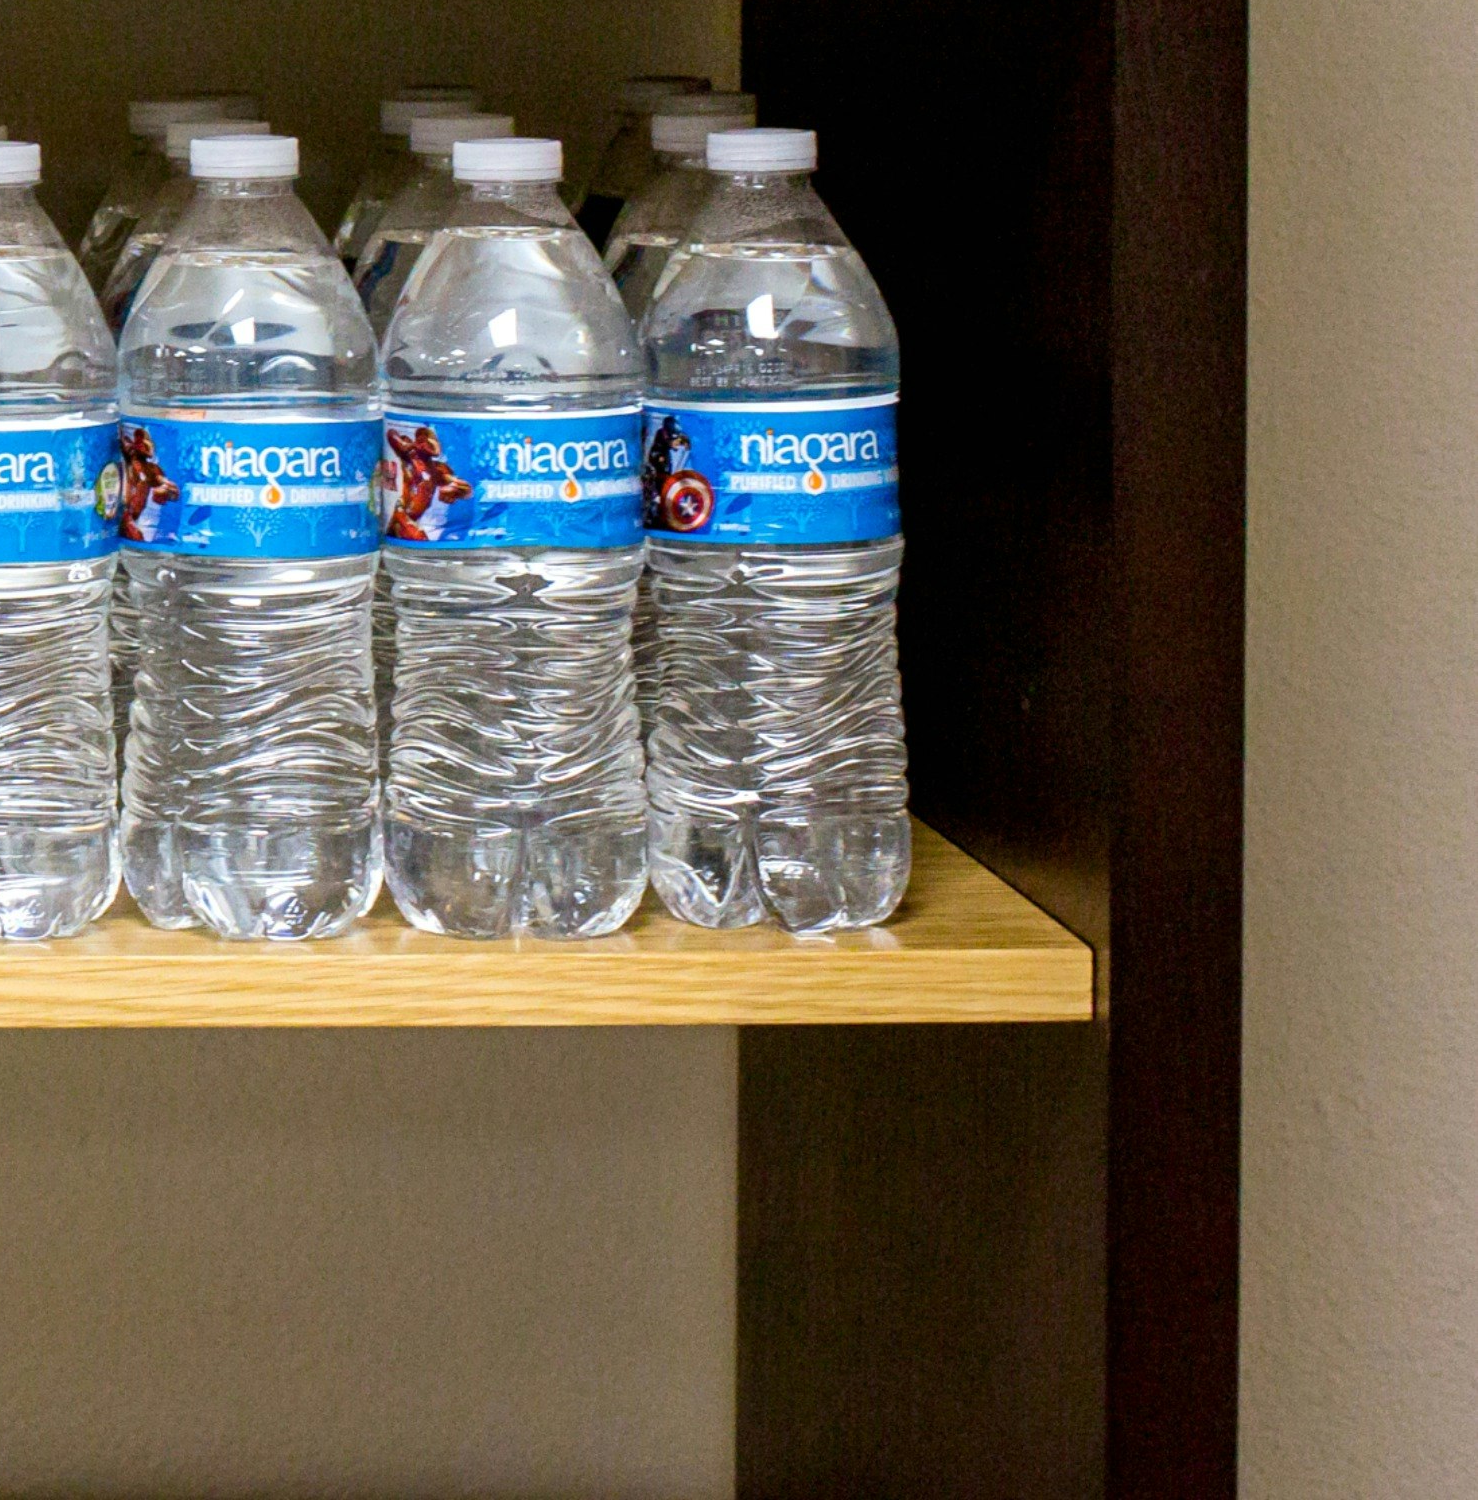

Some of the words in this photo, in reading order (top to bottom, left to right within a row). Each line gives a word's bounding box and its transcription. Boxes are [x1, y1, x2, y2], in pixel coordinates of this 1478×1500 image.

[201, 441, 342, 509] niagara
[497, 436, 630, 502] niagara
[730, 474, 797, 491] PURIFIED
[740, 428, 880, 495] niagara
[191, 487, 254, 505] PURIFIED
[487, 483, 554, 500] PURIFIED
